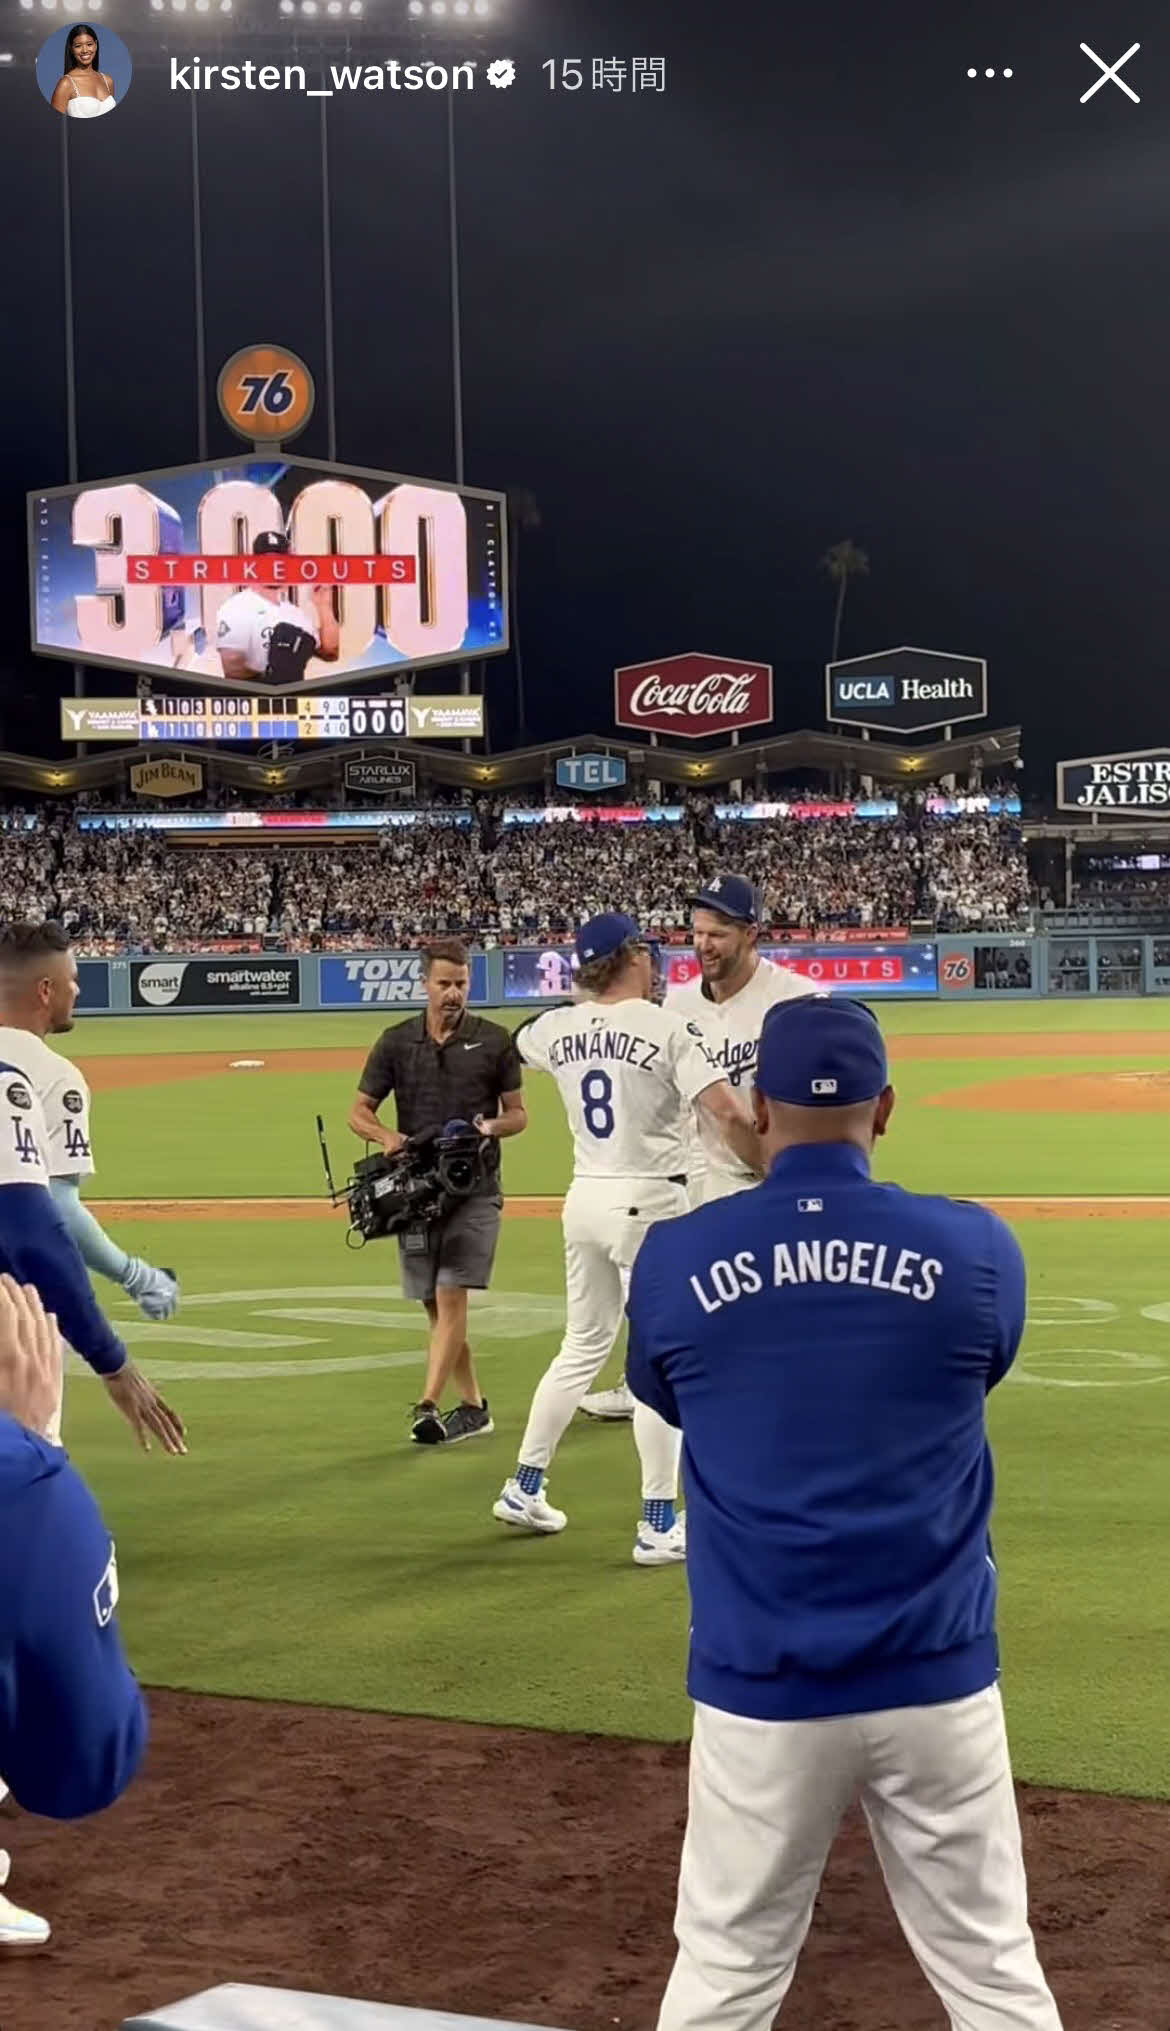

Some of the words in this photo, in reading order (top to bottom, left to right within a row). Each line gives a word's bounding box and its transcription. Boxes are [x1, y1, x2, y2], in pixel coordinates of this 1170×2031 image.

[237, 371, 295, 415] 76
[134, 559, 407, 580] STRIKEOUTS
[629, 672, 757, 717] Coca-Cola
[839, 682, 890, 700] UCLA
[901, 678, 973, 700] Health
[349, 765, 411, 776] STARLUX
[565, 761, 618, 784] TEL
[1077, 783, 1170, 806] JALIS
[207, 969, 292, 984] smartwater
[945, 961, 969, 980] 76
[140, 977, 179, 989] smart
[581, 1069, 615, 1139] 8
[10, 1115, 41, 1166] LA
[63, 1119, 91, 1157] LA
[689, 1251, 763, 1314] LOS
[773, 1239, 943, 1301] ANGELES
